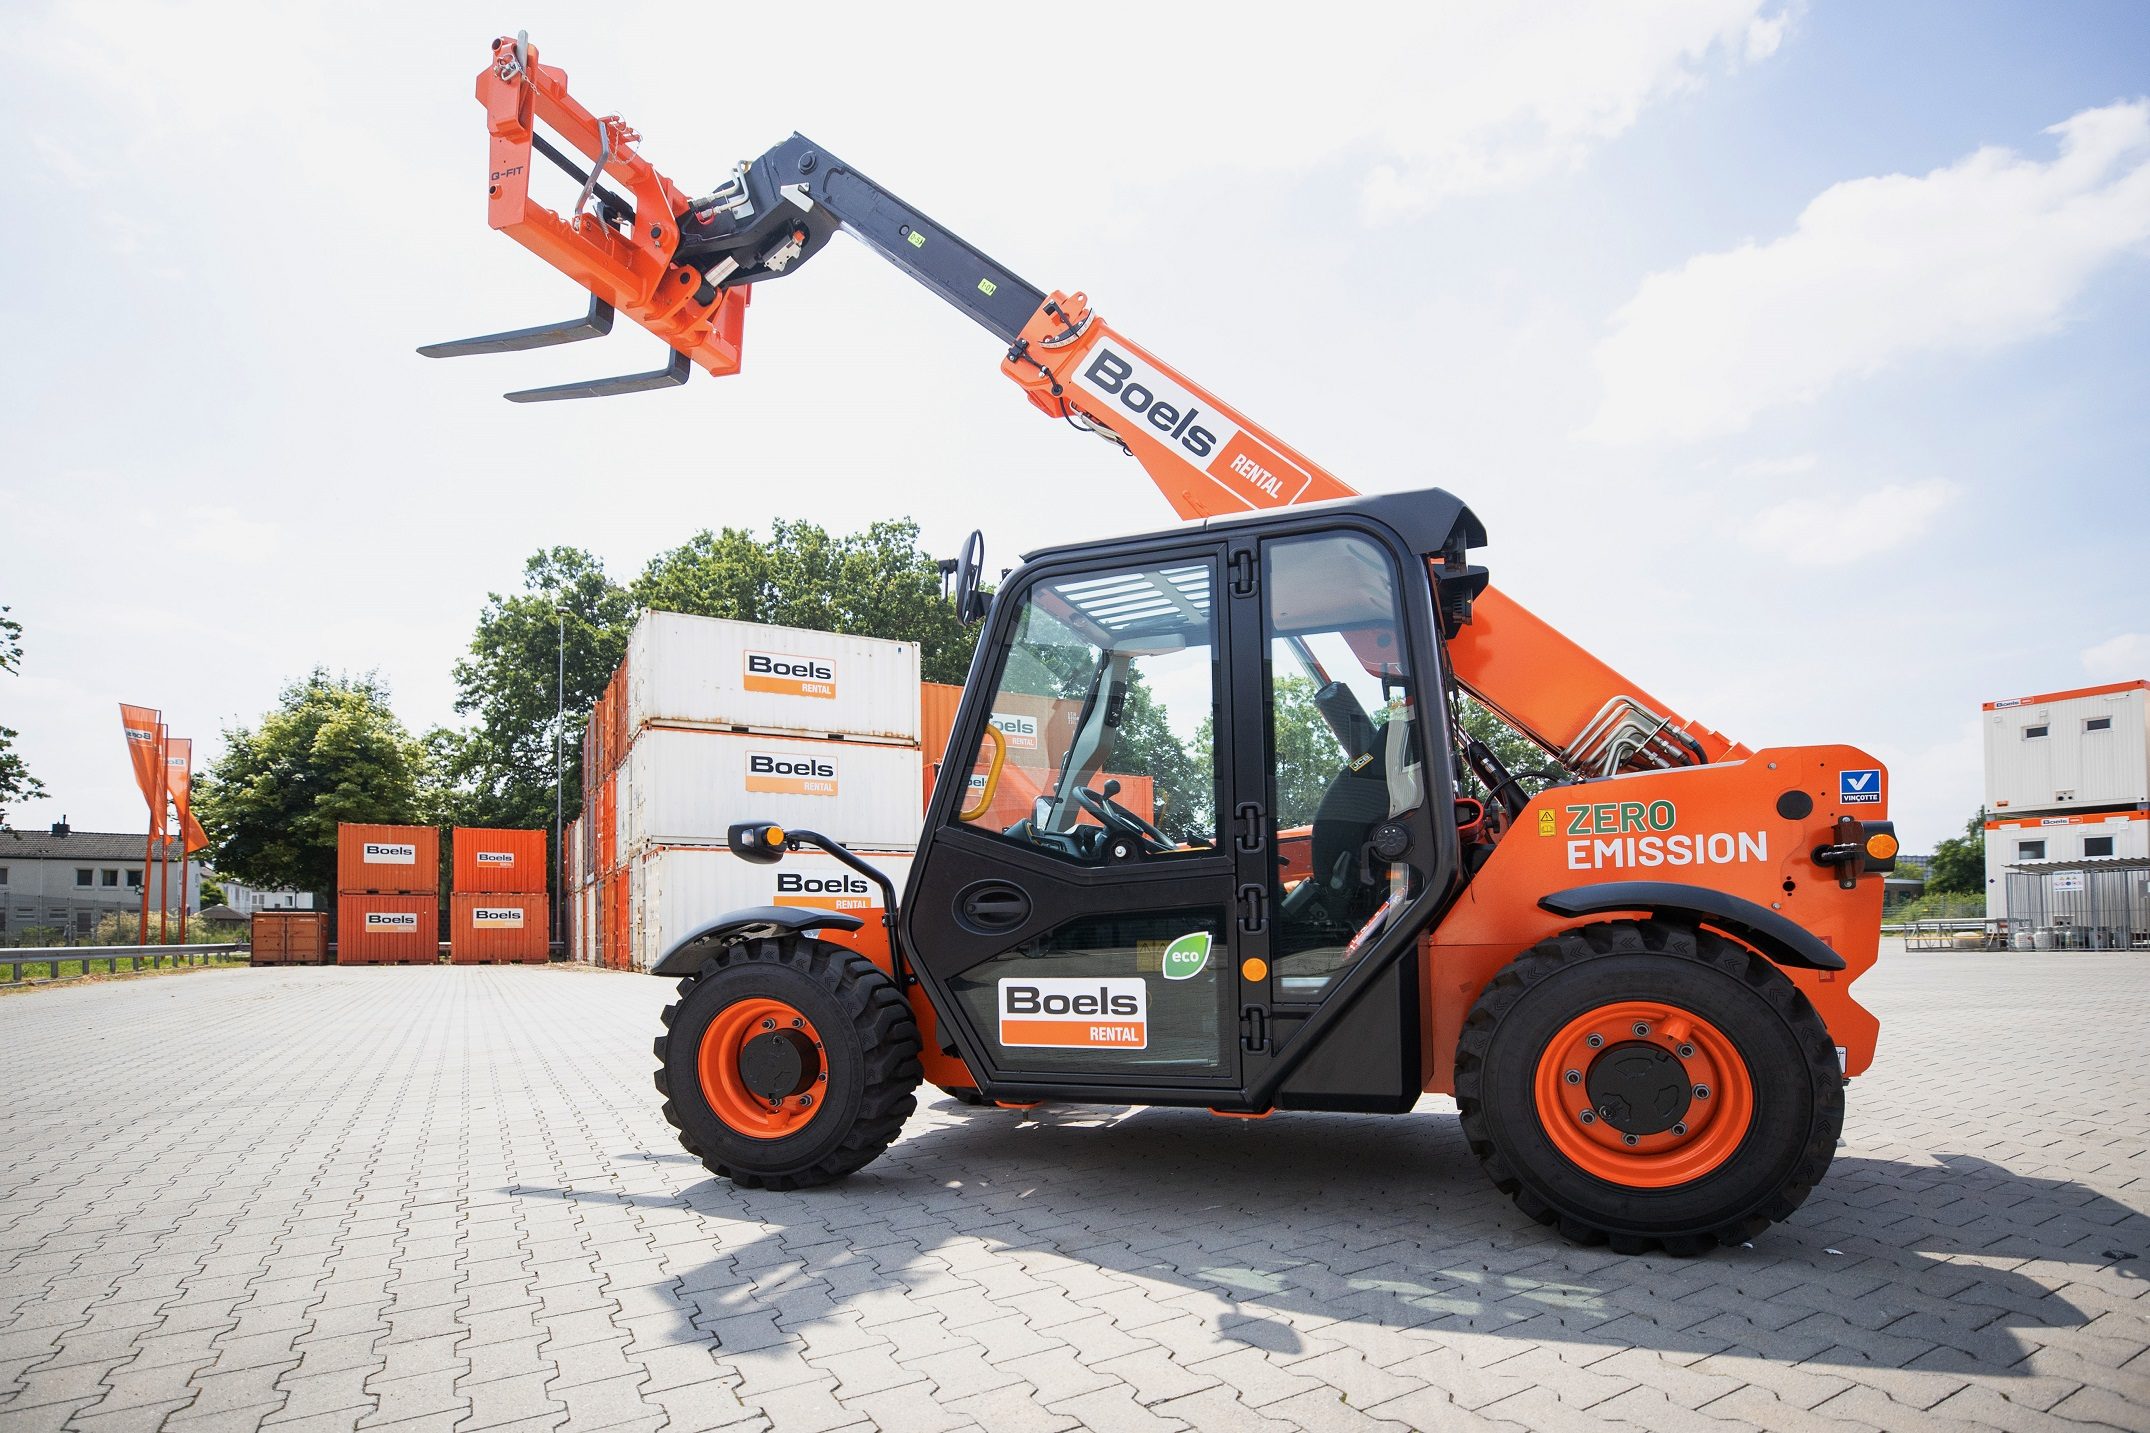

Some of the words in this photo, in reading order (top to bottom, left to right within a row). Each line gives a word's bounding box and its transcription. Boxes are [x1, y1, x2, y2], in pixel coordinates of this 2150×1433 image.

[491, 166, 524, 181] Q-FIT
[1084, 348, 1217, 458] Boels
[1230, 453, 1284, 499] RENTAL
[748, 655, 832, 680] Boels
[801, 683, 832, 695] RENTAL
[1012, 737, 1034, 746] RENTAL
[750, 755, 834, 777] Boels
[1352, 754, 1370, 769] JCB
[804, 781, 834, 792] RENTAL
[1843, 794, 1878, 802] VINÇOTTE
[1566, 799, 1677, 836] ZERO
[366, 845, 413, 856] Boels
[478, 853, 512, 862] Boels
[1567, 830, 1768, 870] EMISSION
[777, 873, 868, 893] Boels
[368, 915, 415, 924] Boels
[476, 910, 521, 920] Boels
[1171, 951, 1200, 963] eco
[1006, 986, 1139, 1016] Boels
[1089, 1026, 1139, 1042] RENTAL
